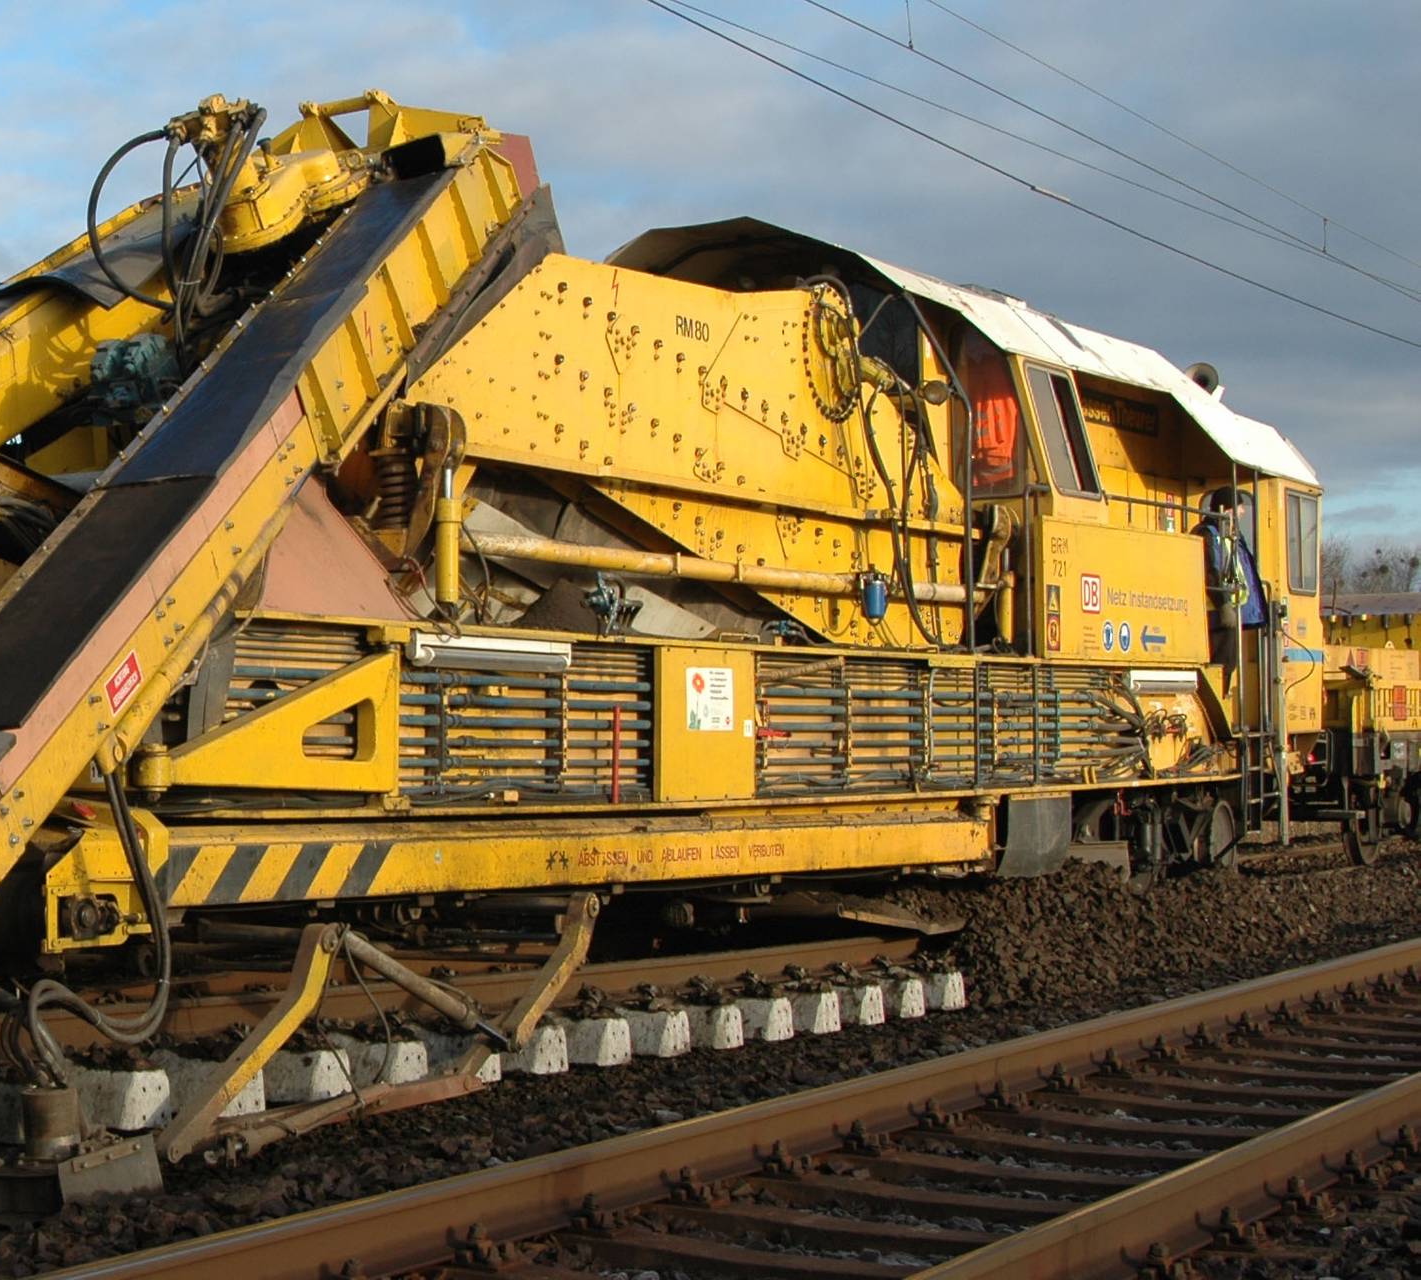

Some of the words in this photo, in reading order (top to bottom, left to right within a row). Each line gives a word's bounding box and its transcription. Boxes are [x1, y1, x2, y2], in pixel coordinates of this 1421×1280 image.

[1052, 559, 1067, 578] 721
[1083, 579, 1099, 608] DB
[1106, 586, 1128, 607] Netz
[1129, 590, 1189, 617] Instandsetzung
[636, 848, 654, 864] UND
[662, 846, 702, 863] ABLAUFEN
[710, 844, 740, 861] LASSEN
[748, 842, 785, 858] VERBOTEN
